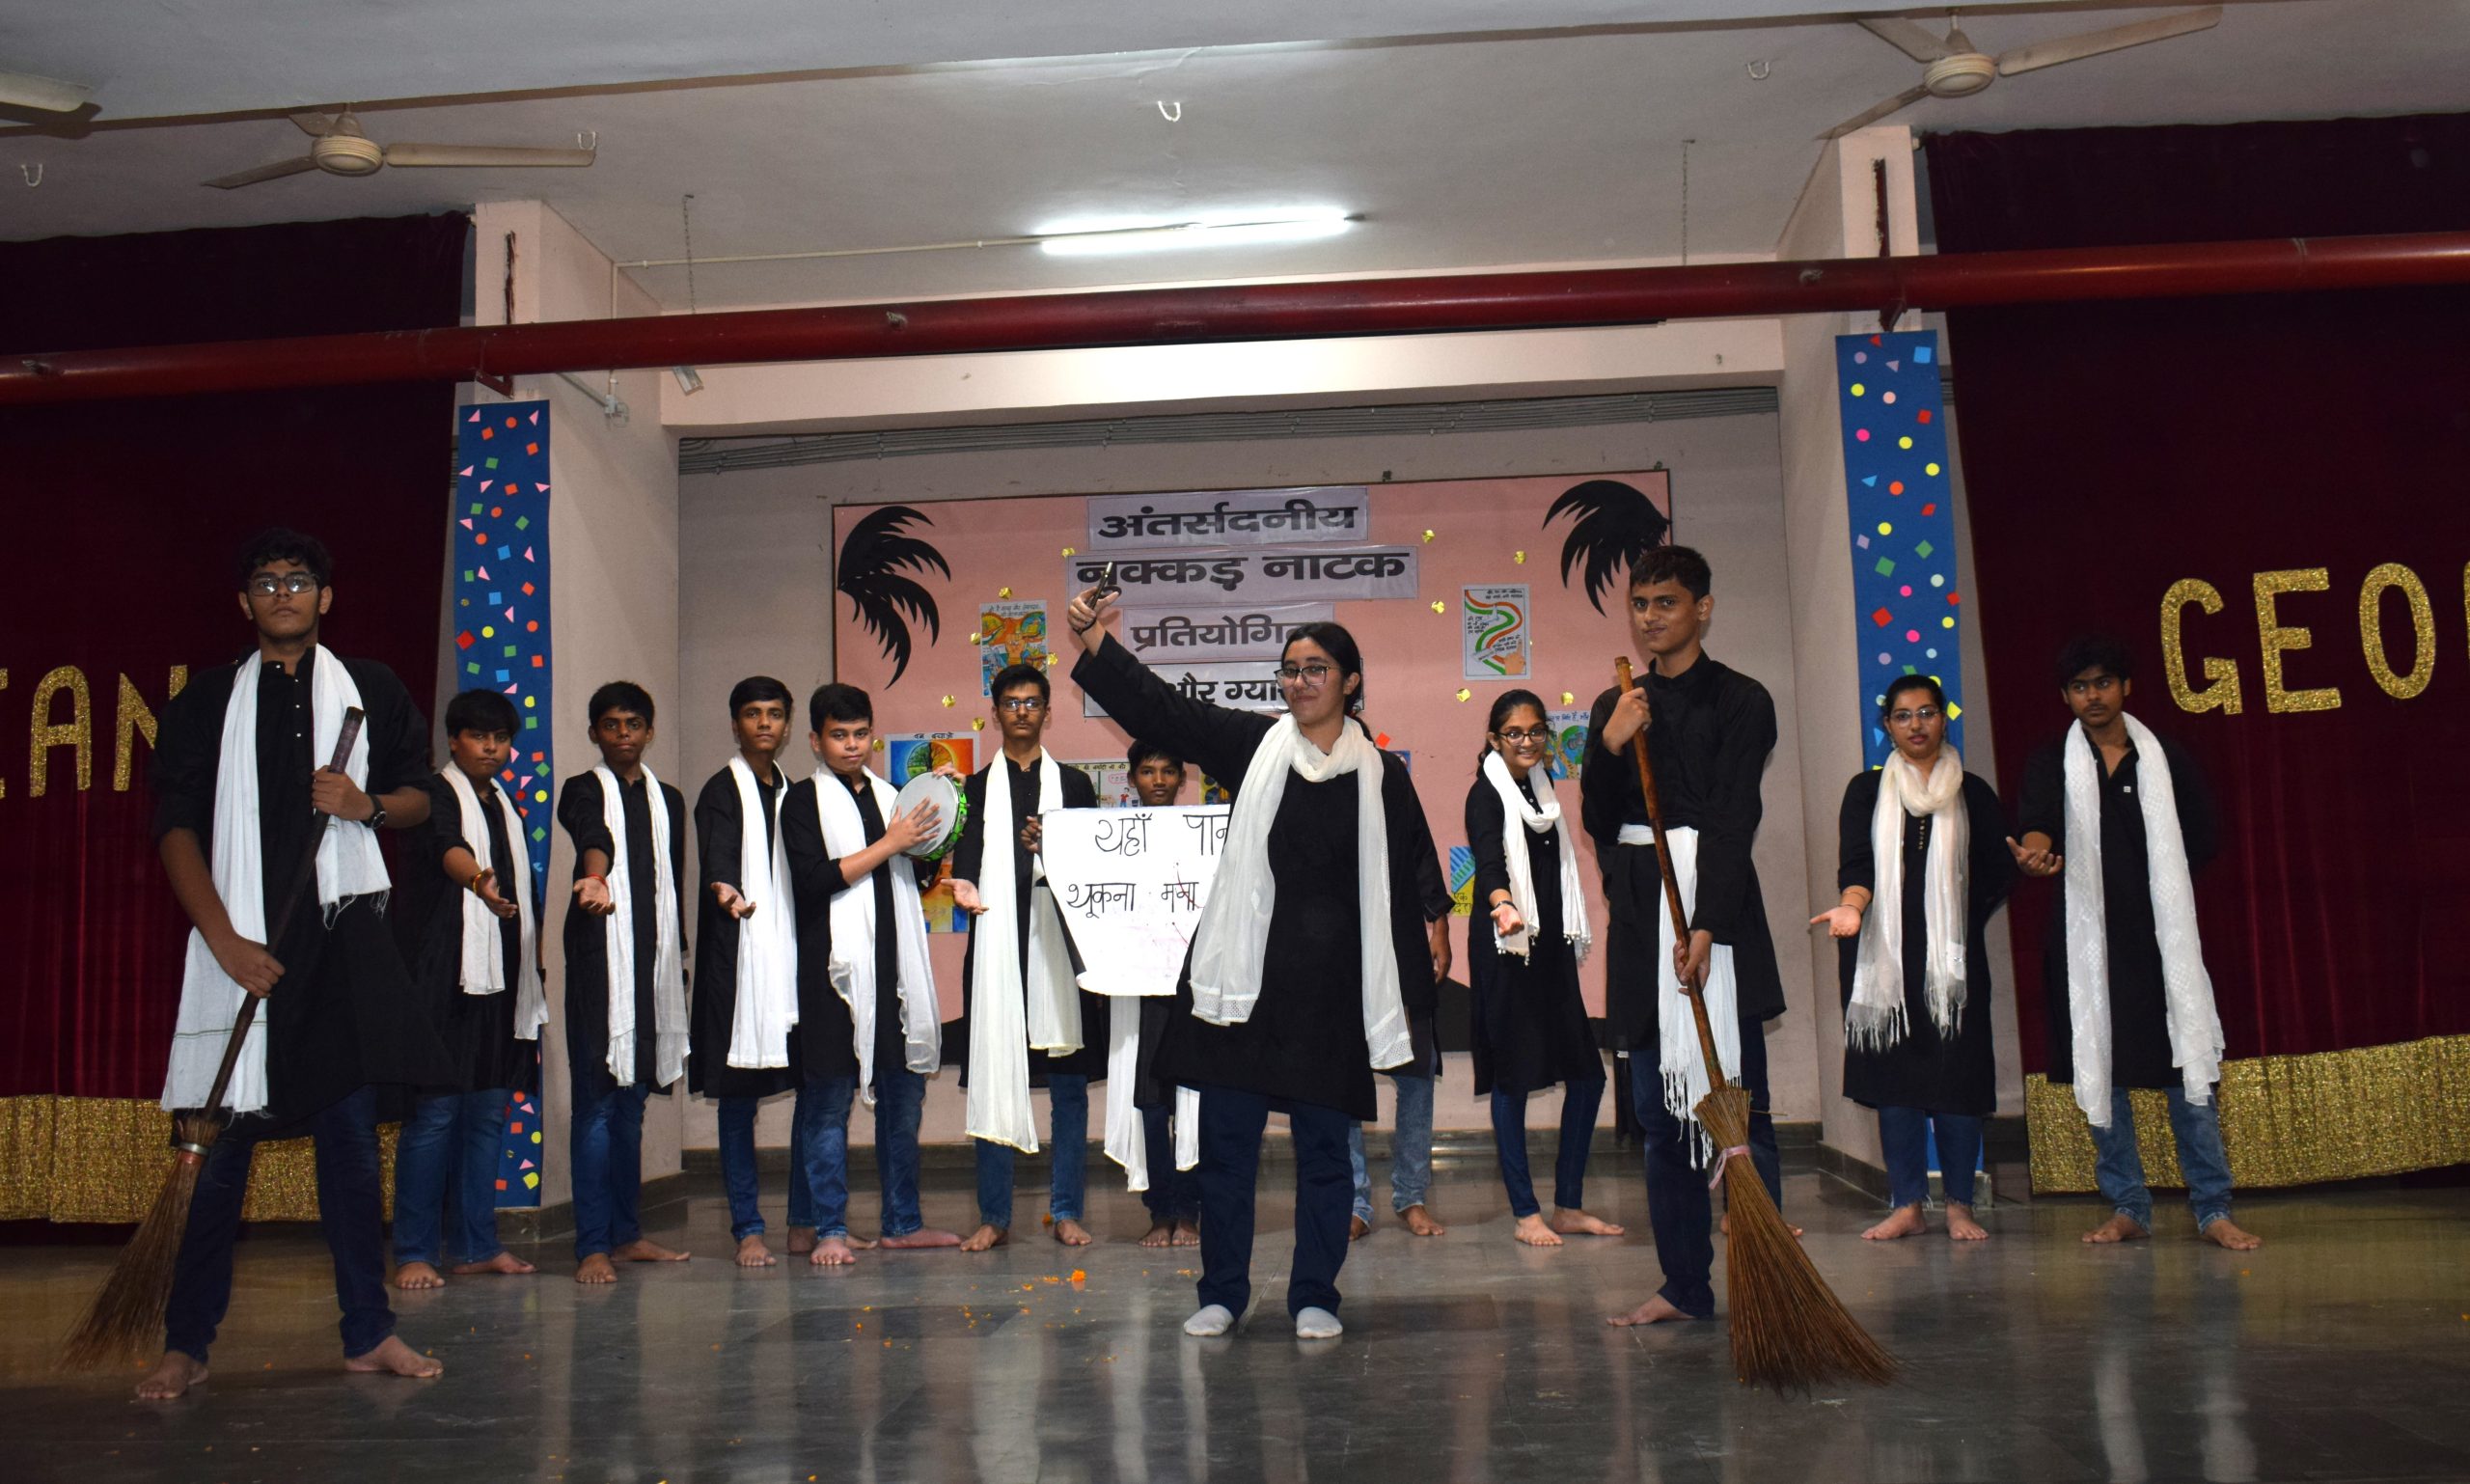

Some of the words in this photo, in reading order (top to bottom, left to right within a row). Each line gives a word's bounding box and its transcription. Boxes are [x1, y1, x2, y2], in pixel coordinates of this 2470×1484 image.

[1098, 499, 1358, 537] अंतर्सदनीय
[1263, 552, 1410, 581] नाटक
[1130, 614, 1304, 652] प्रतियोगि
[2160, 561, 2470, 715] GEO
[1223, 679, 1287, 701] ग्या
[0, 665, 188, 799] AN
[1095, 812, 1153, 856] यहाँ
[1066, 882, 1137, 919] थूकना
